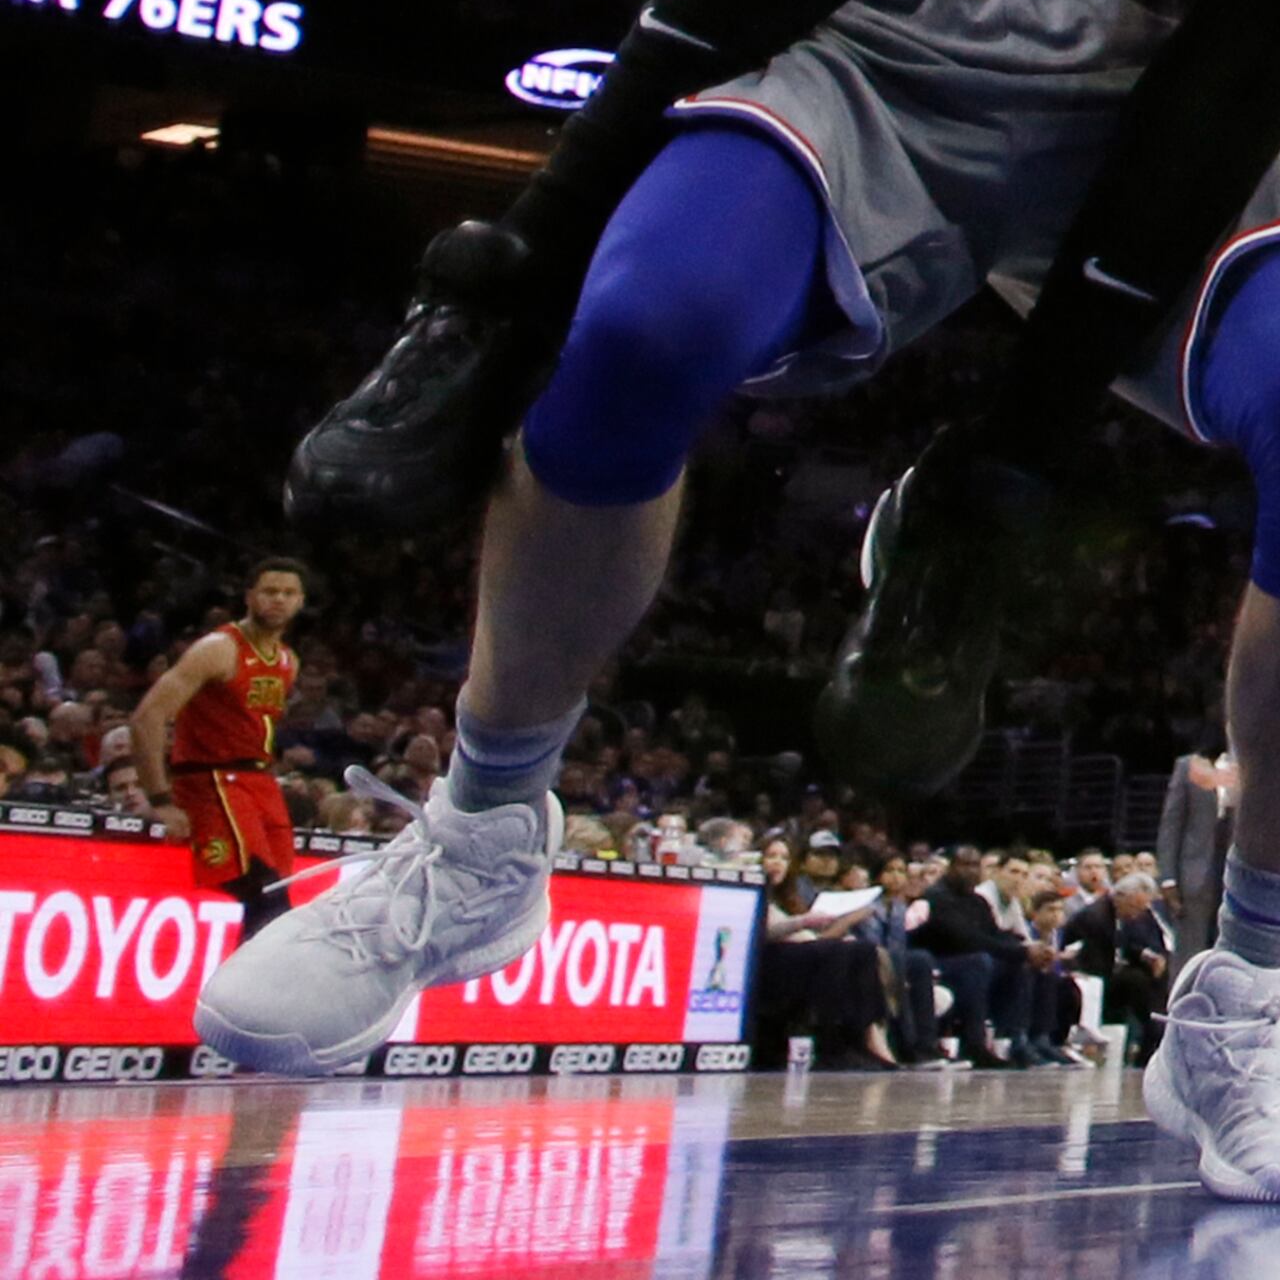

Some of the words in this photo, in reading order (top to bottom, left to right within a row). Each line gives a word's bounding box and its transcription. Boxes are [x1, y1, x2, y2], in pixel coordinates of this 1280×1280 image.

[0, 889, 245, 1002] TOYOT
[63, 1046, 163, 1081] GEICO
[384, 1044, 455, 1074] GEICO
[462, 1044, 535, 1073] GEICO
[549, 1043, 615, 1073] GEICO
[623, 1043, 684, 1072] GEICO
[695, 1043, 750, 1071] GEICO
